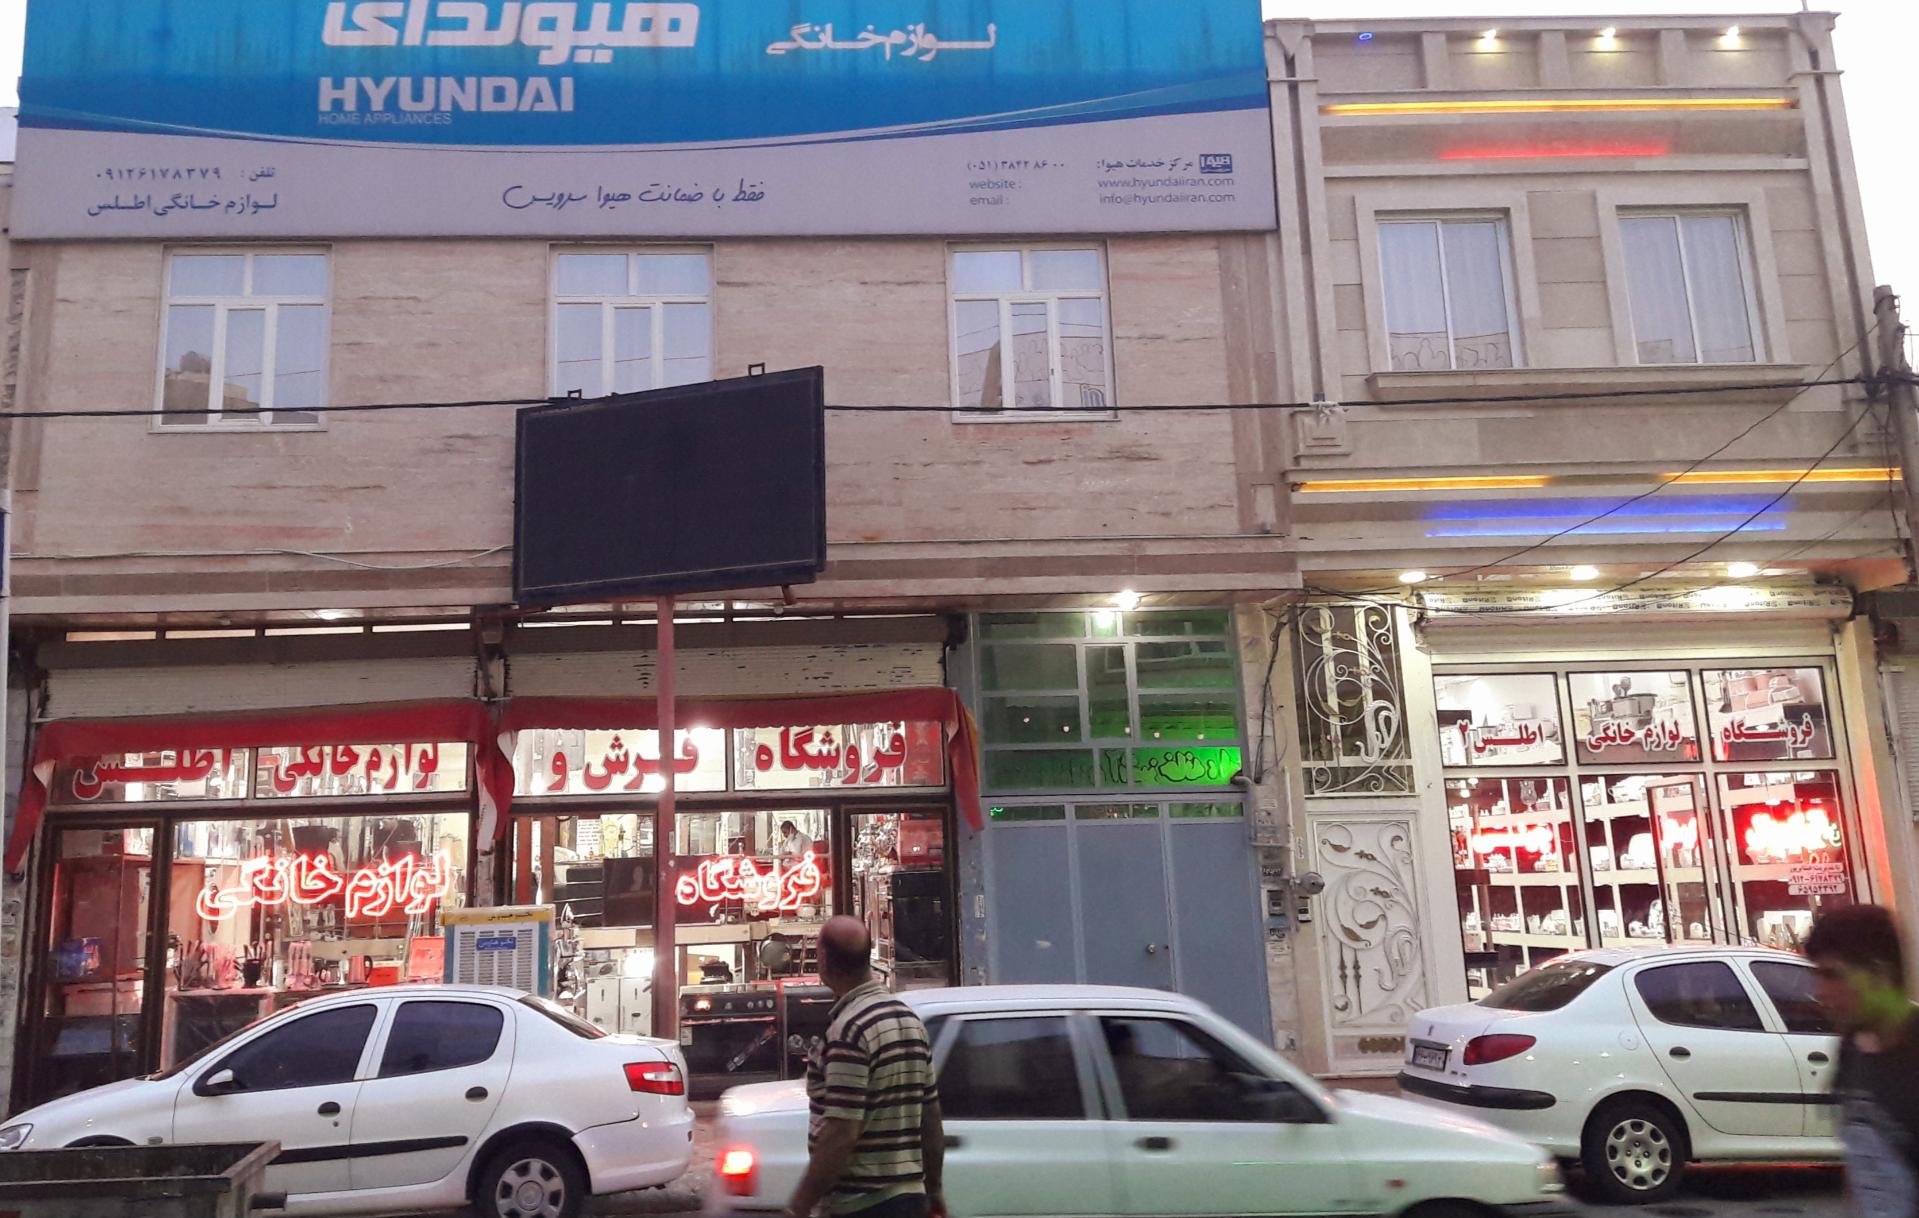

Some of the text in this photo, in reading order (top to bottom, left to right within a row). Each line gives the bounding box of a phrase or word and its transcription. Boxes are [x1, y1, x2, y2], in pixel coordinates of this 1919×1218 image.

[887, 22, 997, 62] لوازم
[318, 77, 574, 112] HYUNDAI
[318, 113, 452, 125] HOME APPLIANCES
[503, 178, 765, 210] فقط با ضمانت هیوا سرویس
[1097, 176, 1235, 190] www.hyundaiiran.com
[88, 193, 278, 216] لوازم خانگی اطلس
[1474, 722, 1545, 753] اطلس
[1588, 720, 1636, 752] خانگی
[1641, 720, 1682, 752] لوازم
[1722, 714, 1814, 748] فروشگاه
[547, 747, 569, 792] و
[755, 720, 908, 786] فروشگاه
[197, 848, 452, 920] لوازم خانگی
[675, 850, 822, 912] فروشگاه
